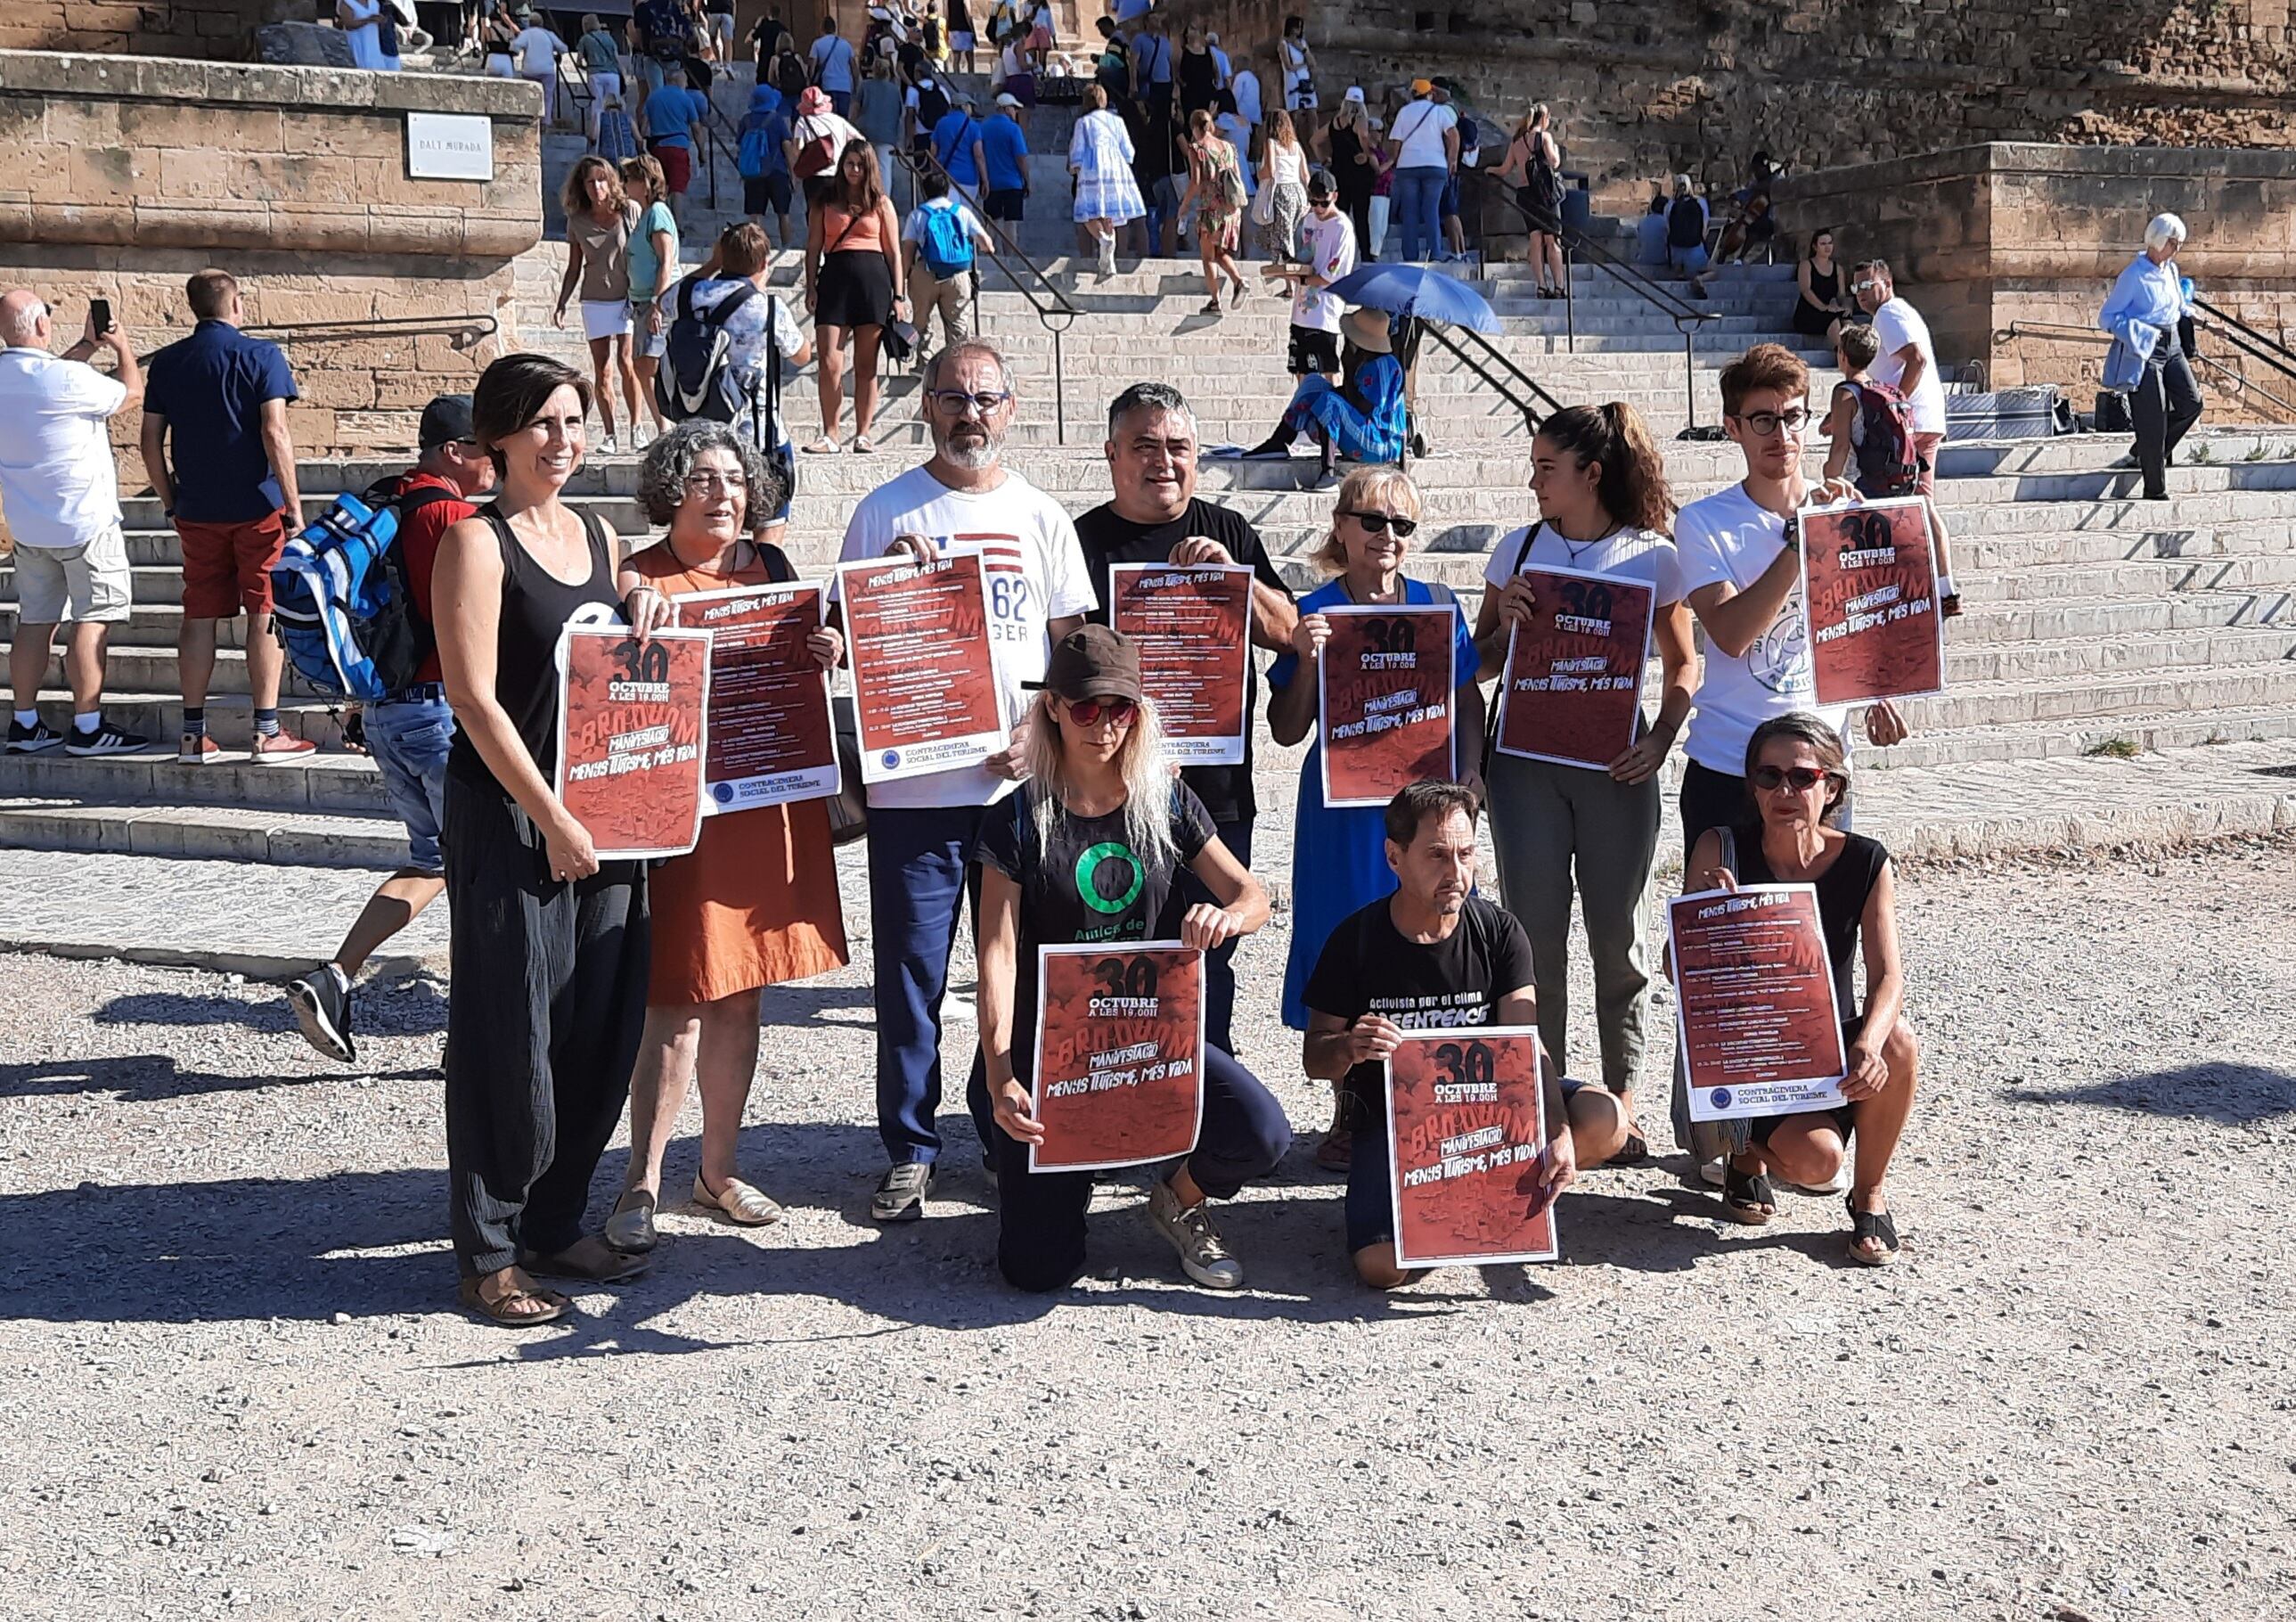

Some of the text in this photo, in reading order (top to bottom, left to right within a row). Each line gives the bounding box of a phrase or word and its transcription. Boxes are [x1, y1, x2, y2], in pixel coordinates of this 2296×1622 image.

[420, 140, 481, 152] DALT MURADA
[1839, 512, 1892, 552] 30
[1839, 547, 1895, 561] OCTUBRE
[1840, 561, 1846, 569] A
[1848, 560, 1863, 568] LES
[992, 578, 1026, 622] 62
[1559, 583, 1612, 618] 30
[1555, 614, 1611, 629] OCTUBRE
[1363, 618, 1415, 652] 30
[1816, 622, 1847, 643] MENYS
[613, 640, 669, 683] 30
[1360, 652, 1416, 662] OCTUBRE
[609, 682, 669, 693] OCTUBRE
[609, 692, 616, 700] A
[618, 692, 635, 701] LES
[568, 759, 609, 781] MENYS
[1074, 923, 1121, 941] Amics
[1125, 918, 1144, 930] de
[1093, 955, 1157, 998] 30
[1089, 997, 1158, 1008] OCTUBRE
[1369, 991, 1482, 1009] Activista por el clima
[1088, 1009, 1096, 1017] A
[1099, 1008, 1118, 1017] LES
[1435, 1043, 1494, 1084] 30
[1046, 1078, 1089, 1098] MENYS
[1140, 1061, 1164, 1081] MÉS
[1434, 1083, 1498, 1094] OCTUBRE
[1434, 1094, 1498, 1103] A LES 19.00H
[1738, 1094, 1770, 1104] SOCIAL
[1772, 1094, 1789, 1102] DEL
[1404, 1164, 1442, 1187] MENYS
[1490, 1144, 1512, 1167] MÉS
